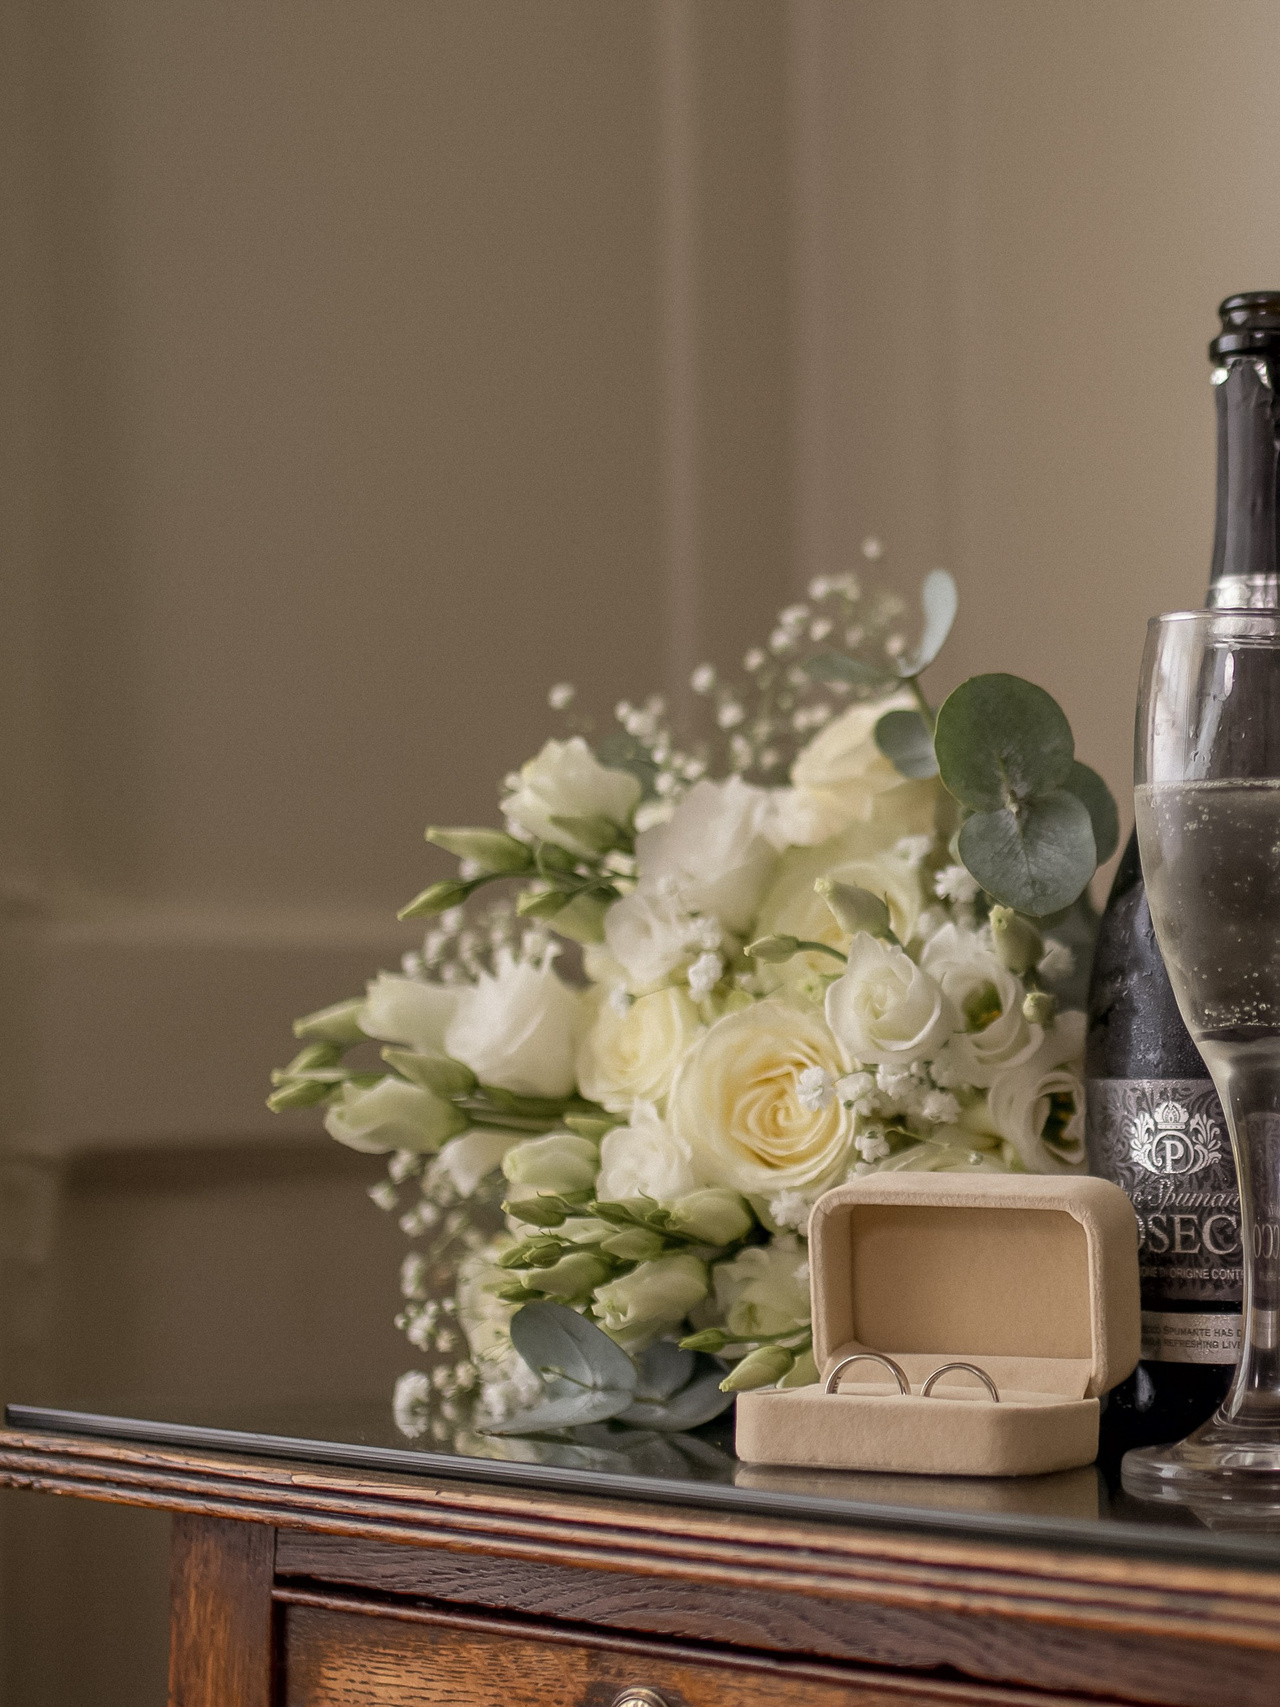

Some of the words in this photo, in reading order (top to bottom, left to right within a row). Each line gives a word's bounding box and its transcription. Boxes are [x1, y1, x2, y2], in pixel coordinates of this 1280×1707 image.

[1147, 1178, 1240, 1214] Spuman
[1169, 1267, 1210, 1279] ORIGINE
[1162, 1325, 1211, 1338] SPUMANTE
[1213, 1328, 1234, 1338] HAS
[1163, 1338, 1219, 1349] REFRESHING
